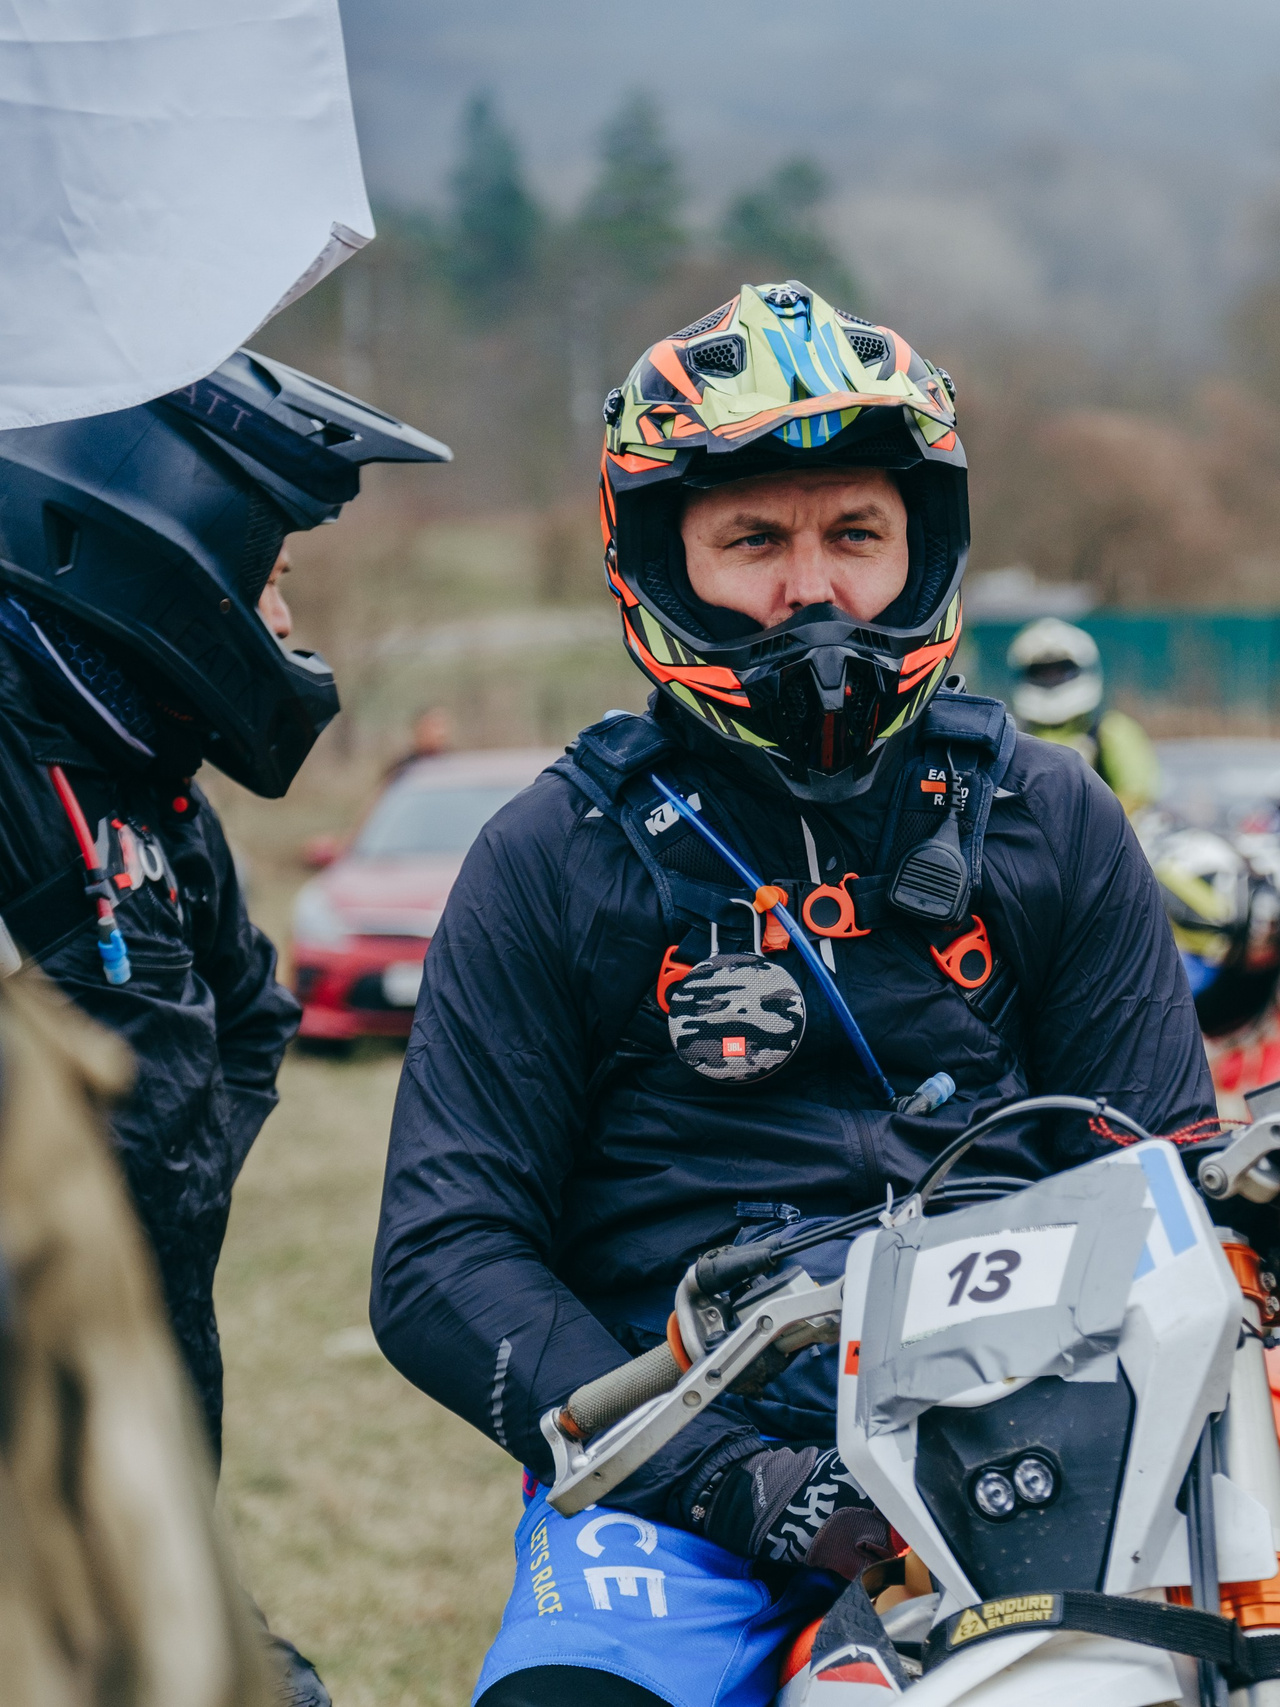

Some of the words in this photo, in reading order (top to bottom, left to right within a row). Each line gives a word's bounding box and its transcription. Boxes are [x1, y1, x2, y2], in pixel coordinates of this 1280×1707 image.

[172, 382, 253, 432] ATT
[727, 1042, 743, 1052] JBL
[948, 1249, 1021, 1307] 13
[530, 1517, 550, 1571] LET'S
[574, 1505, 669, 1618] CE
[531, 1565, 563, 1617] RACE
[982, 1594, 1054, 1619] ENDURO
[986, 1610, 1053, 1630] ELEMENT
